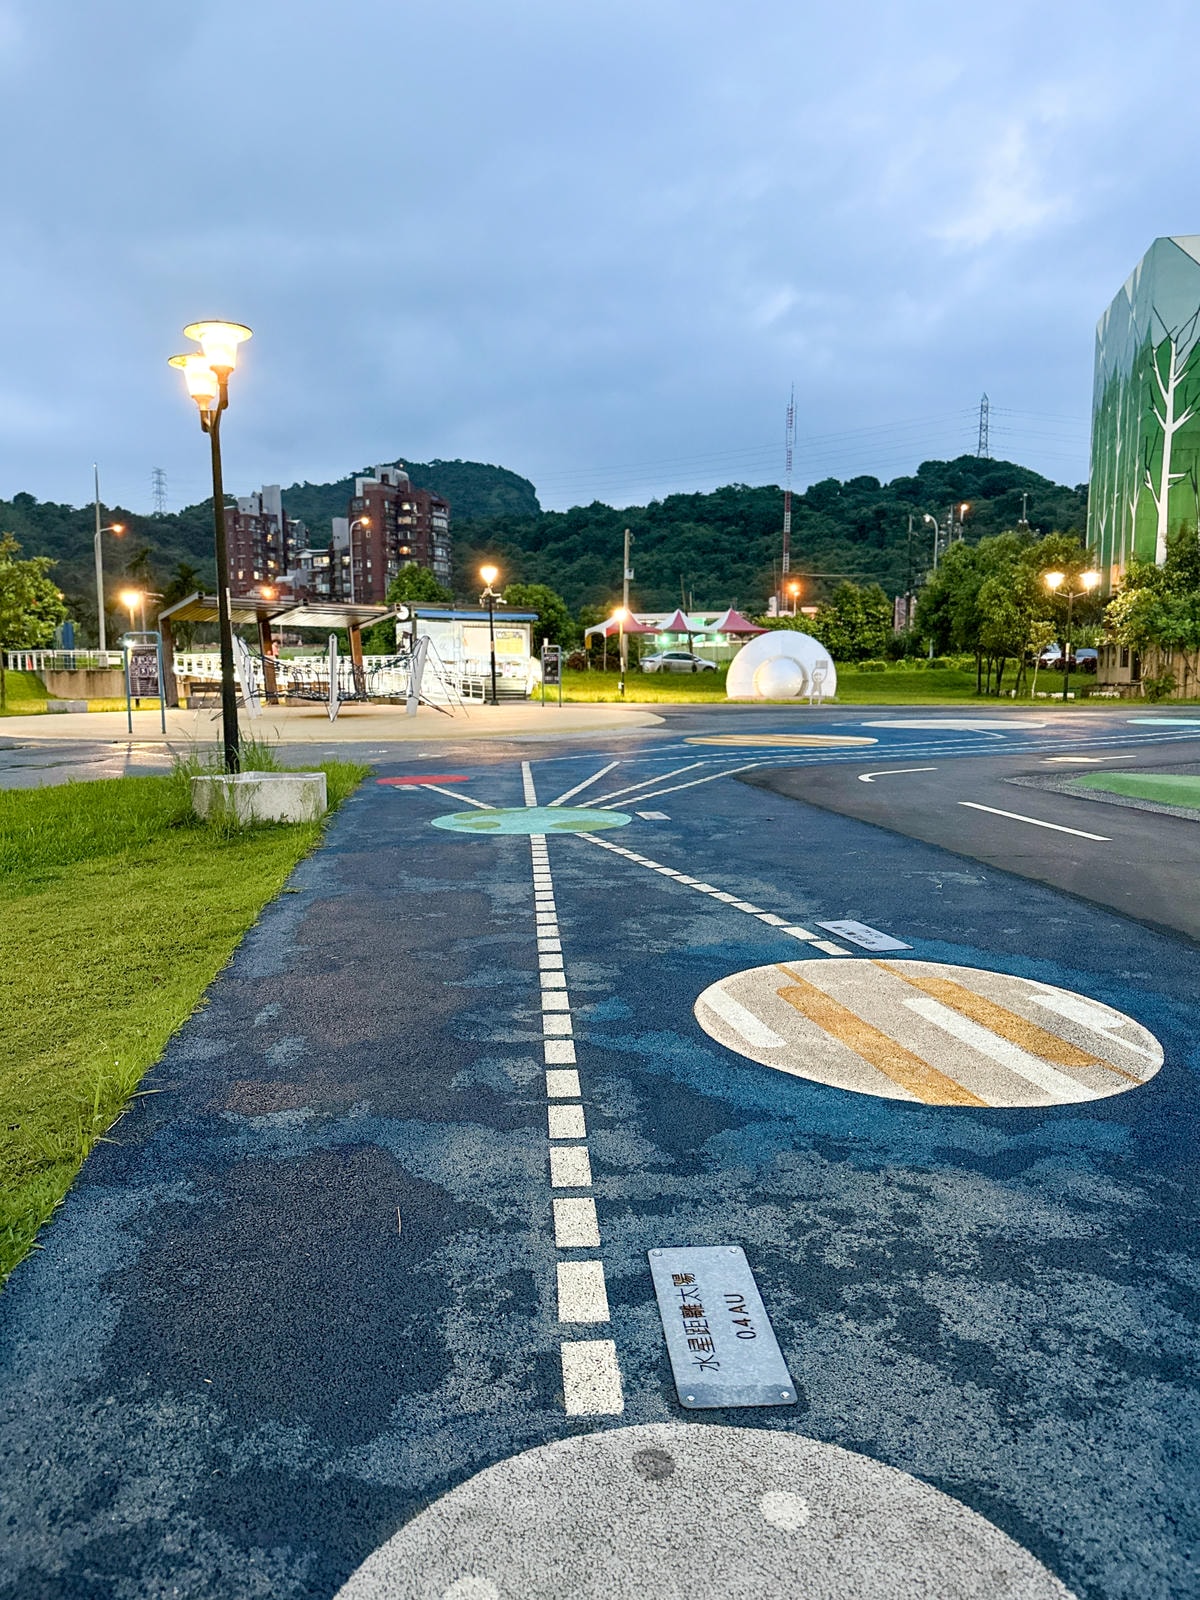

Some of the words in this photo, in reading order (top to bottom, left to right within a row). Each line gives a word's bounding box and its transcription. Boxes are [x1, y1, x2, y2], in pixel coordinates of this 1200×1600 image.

[671, 1272, 721, 1371] 水星距離太陽
